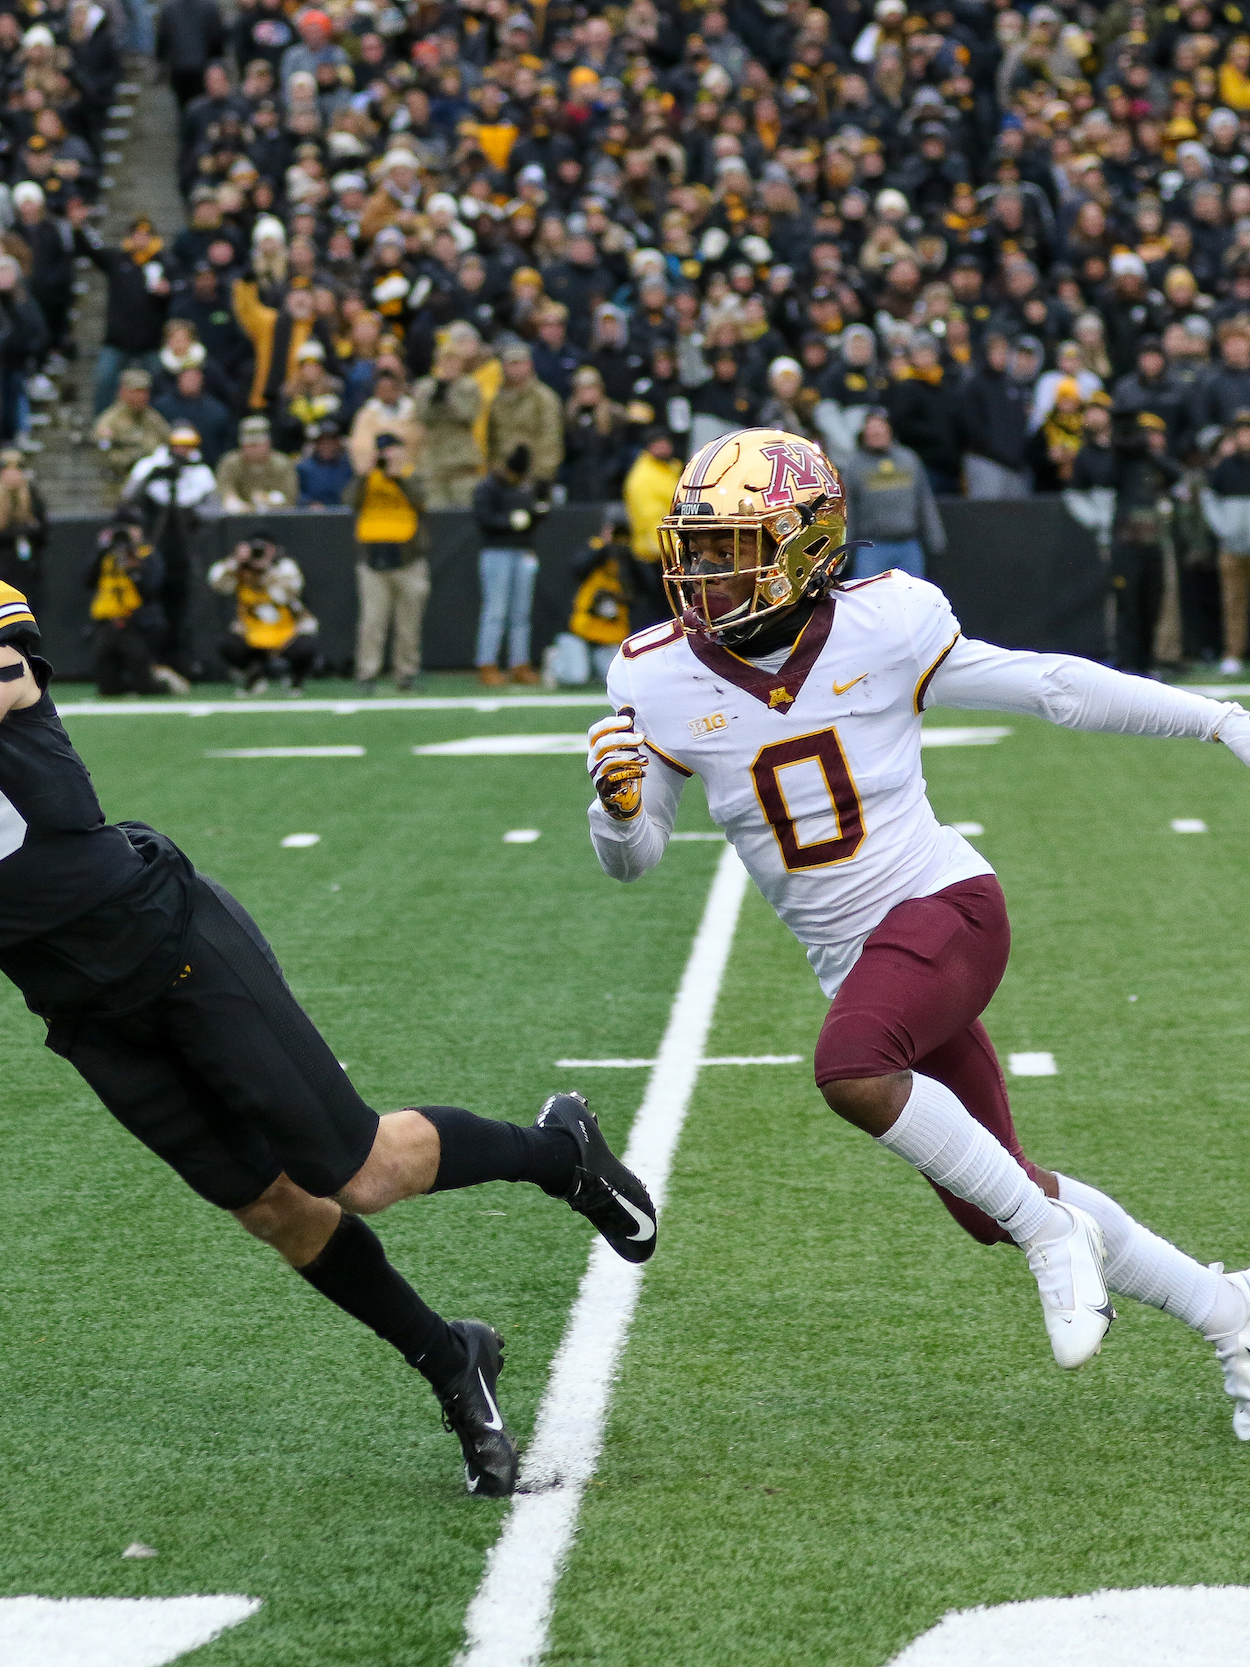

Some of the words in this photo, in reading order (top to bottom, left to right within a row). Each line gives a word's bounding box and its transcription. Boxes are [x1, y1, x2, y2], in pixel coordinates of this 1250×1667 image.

[760, 443, 842, 508] M
[681, 503, 700, 515] ROW
[749, 725, 868, 874] 0
